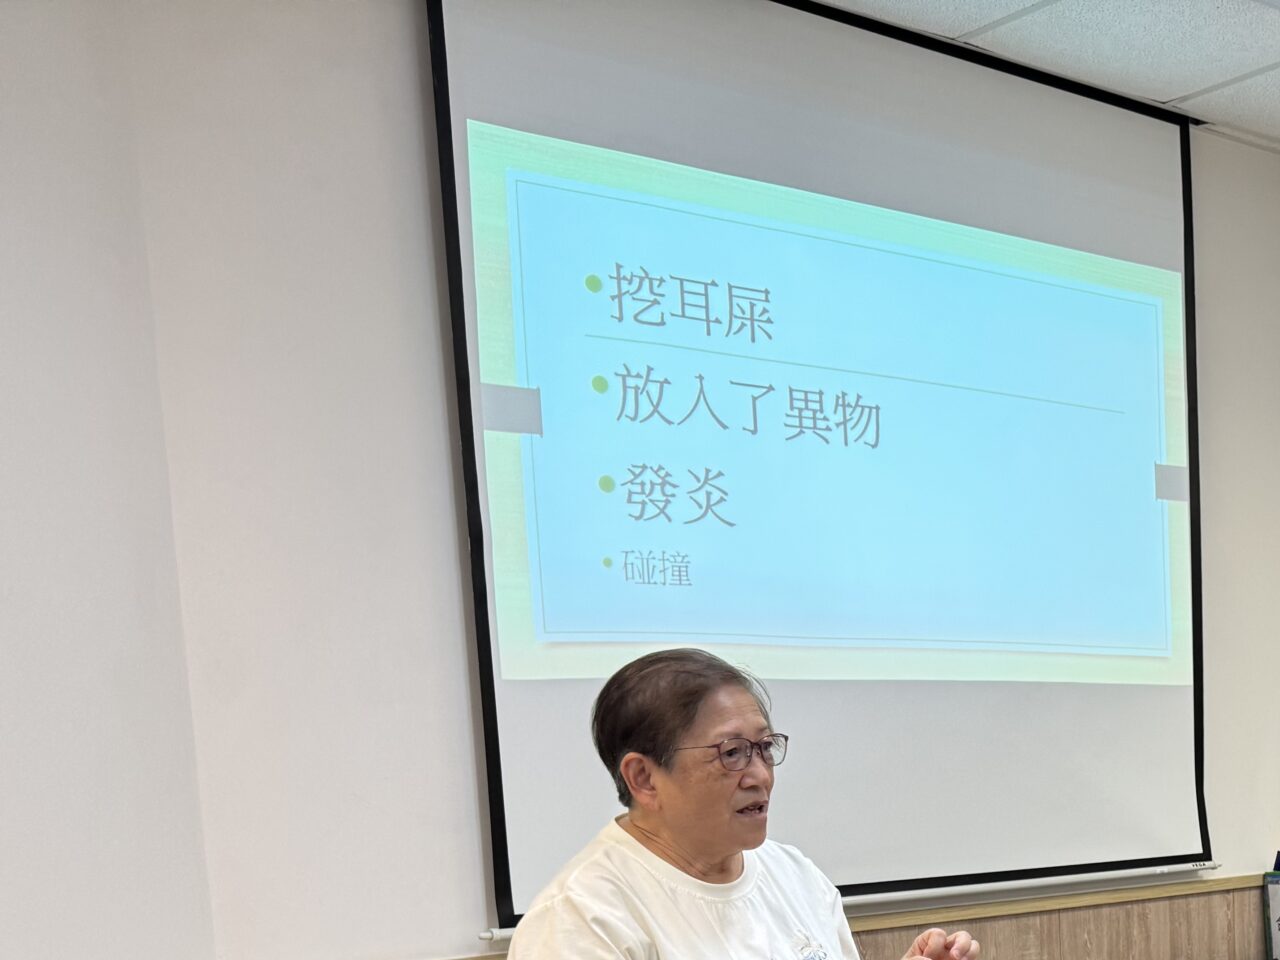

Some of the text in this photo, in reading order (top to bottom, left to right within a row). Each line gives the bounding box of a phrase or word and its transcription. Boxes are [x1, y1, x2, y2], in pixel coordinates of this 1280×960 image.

[608, 262, 775, 344] 挖耳屎
[614, 363, 882, 450] 放入了異物
[620, 462, 736, 529] 發炎
[621, 549, 693, 588] 碰撞
